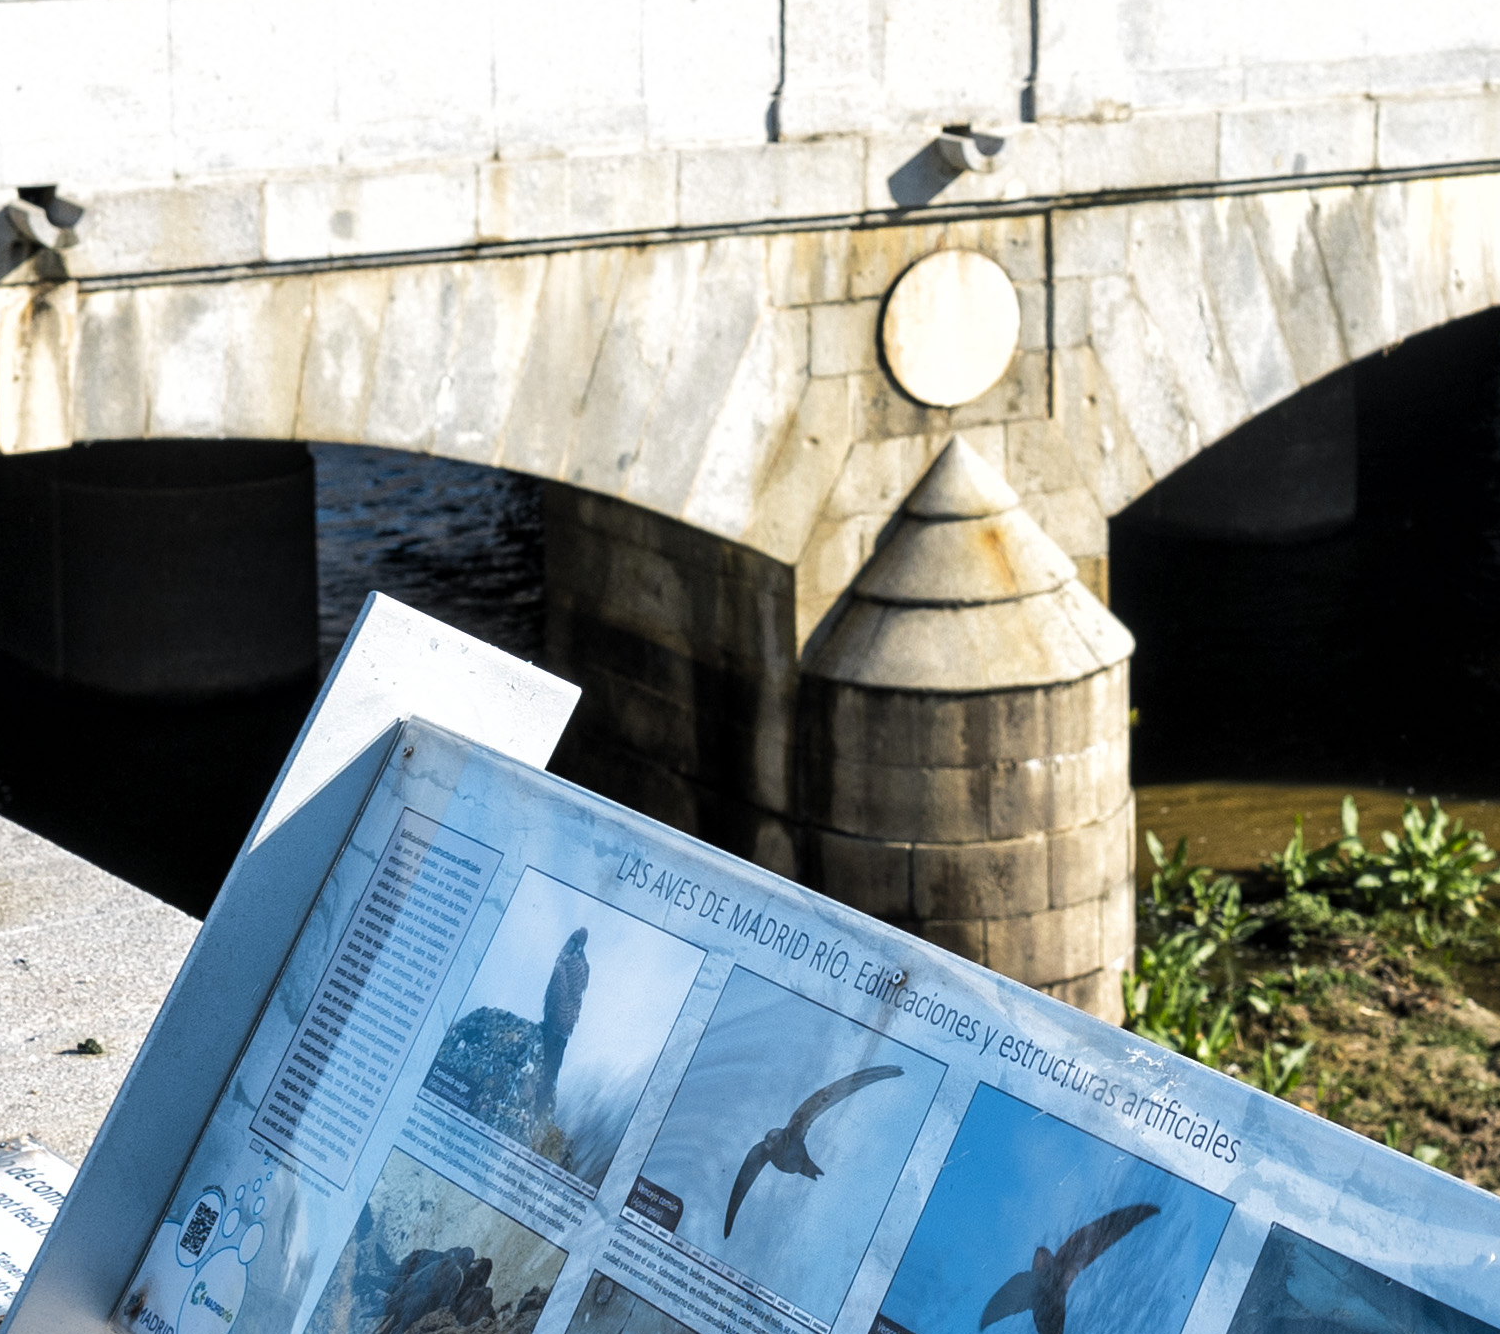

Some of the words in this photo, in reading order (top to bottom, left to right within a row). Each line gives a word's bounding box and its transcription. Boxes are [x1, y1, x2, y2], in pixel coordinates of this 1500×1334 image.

[614, 852, 654, 890] LAS
[647, 867, 702, 912] AVES
[696, 889, 730, 925] DE
[725, 902, 813, 963] MADRID
[807, 931, 861, 984] RÍO.
[851, 958, 986, 1044] Edificaciones
[976, 1025, 999, 1058] y
[995, 1027, 1125, 1109] estructuras
[1118, 1082, 1246, 1165] artificiales
[5, 1167, 45, 1181] dé
[635, 1181, 660, 1203] Vencejo
[658, 1193, 680, 1213] común
[8, 1206, 53, 1229] feed
